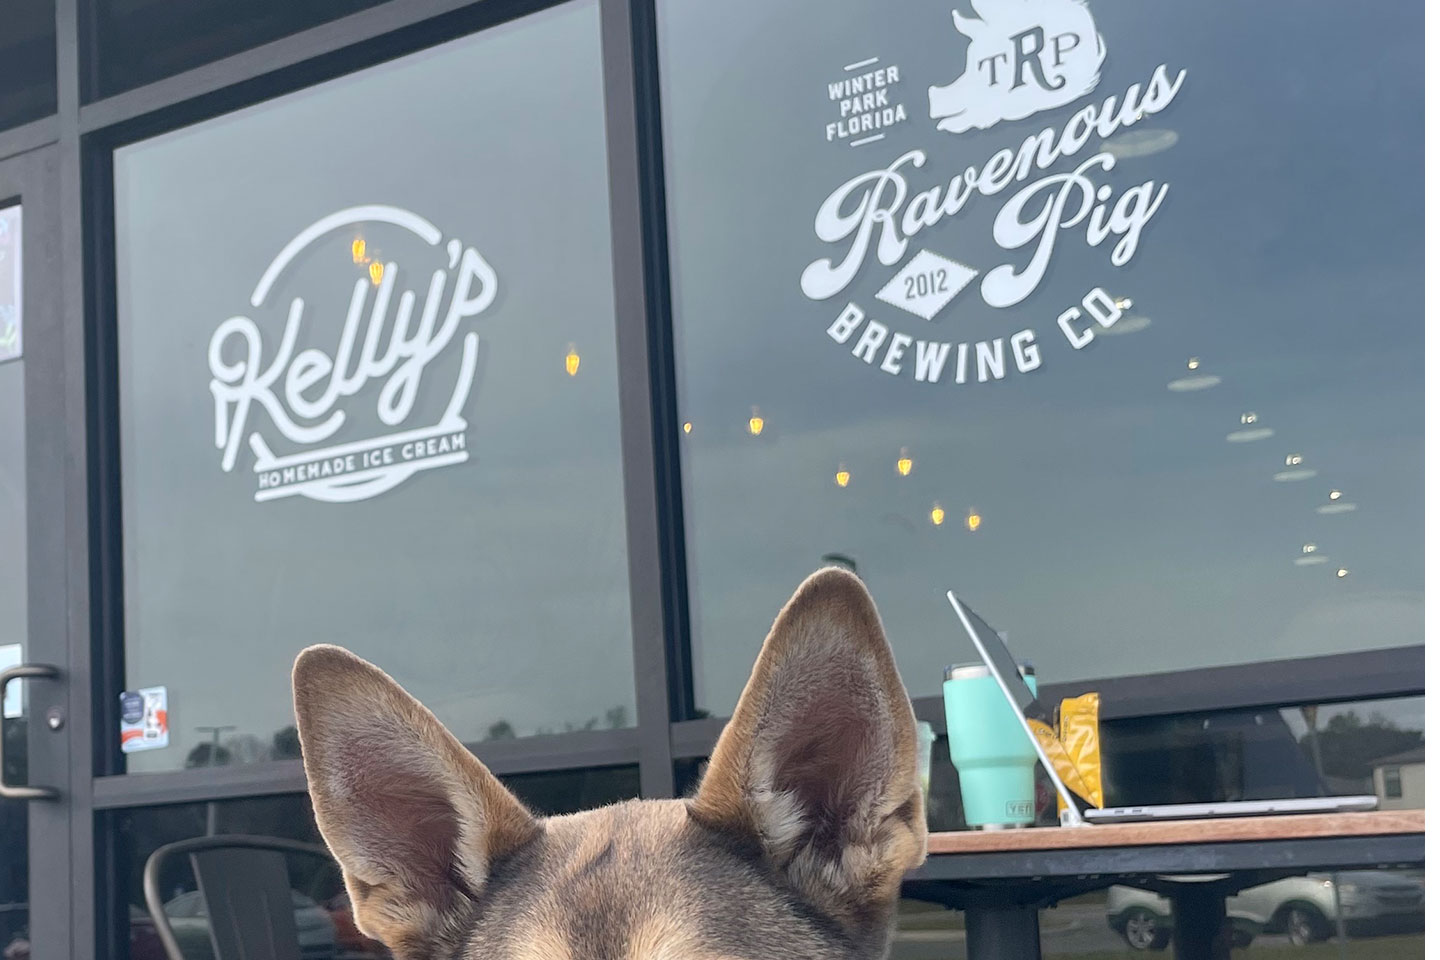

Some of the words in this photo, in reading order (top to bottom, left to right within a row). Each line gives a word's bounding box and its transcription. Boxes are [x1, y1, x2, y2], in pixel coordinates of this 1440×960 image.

[828, 65, 900, 101] WINTER
[978, 26, 1081, 92] TRP
[826, 103, 907, 141] FLORIDA
[840, 88, 888, 118] PARK
[800, 64, 1187, 300] Ravenous
[980, 152, 1169, 308] Pig
[904, 269, 949, 300] 2012
[208, 238, 498, 472] Kelly's
[826, 302, 1042, 384] BREWING
[258, 454, 355, 489] HOMEMADE
[363, 447, 394, 467] ICE
[401, 432, 466, 460] CREAM
